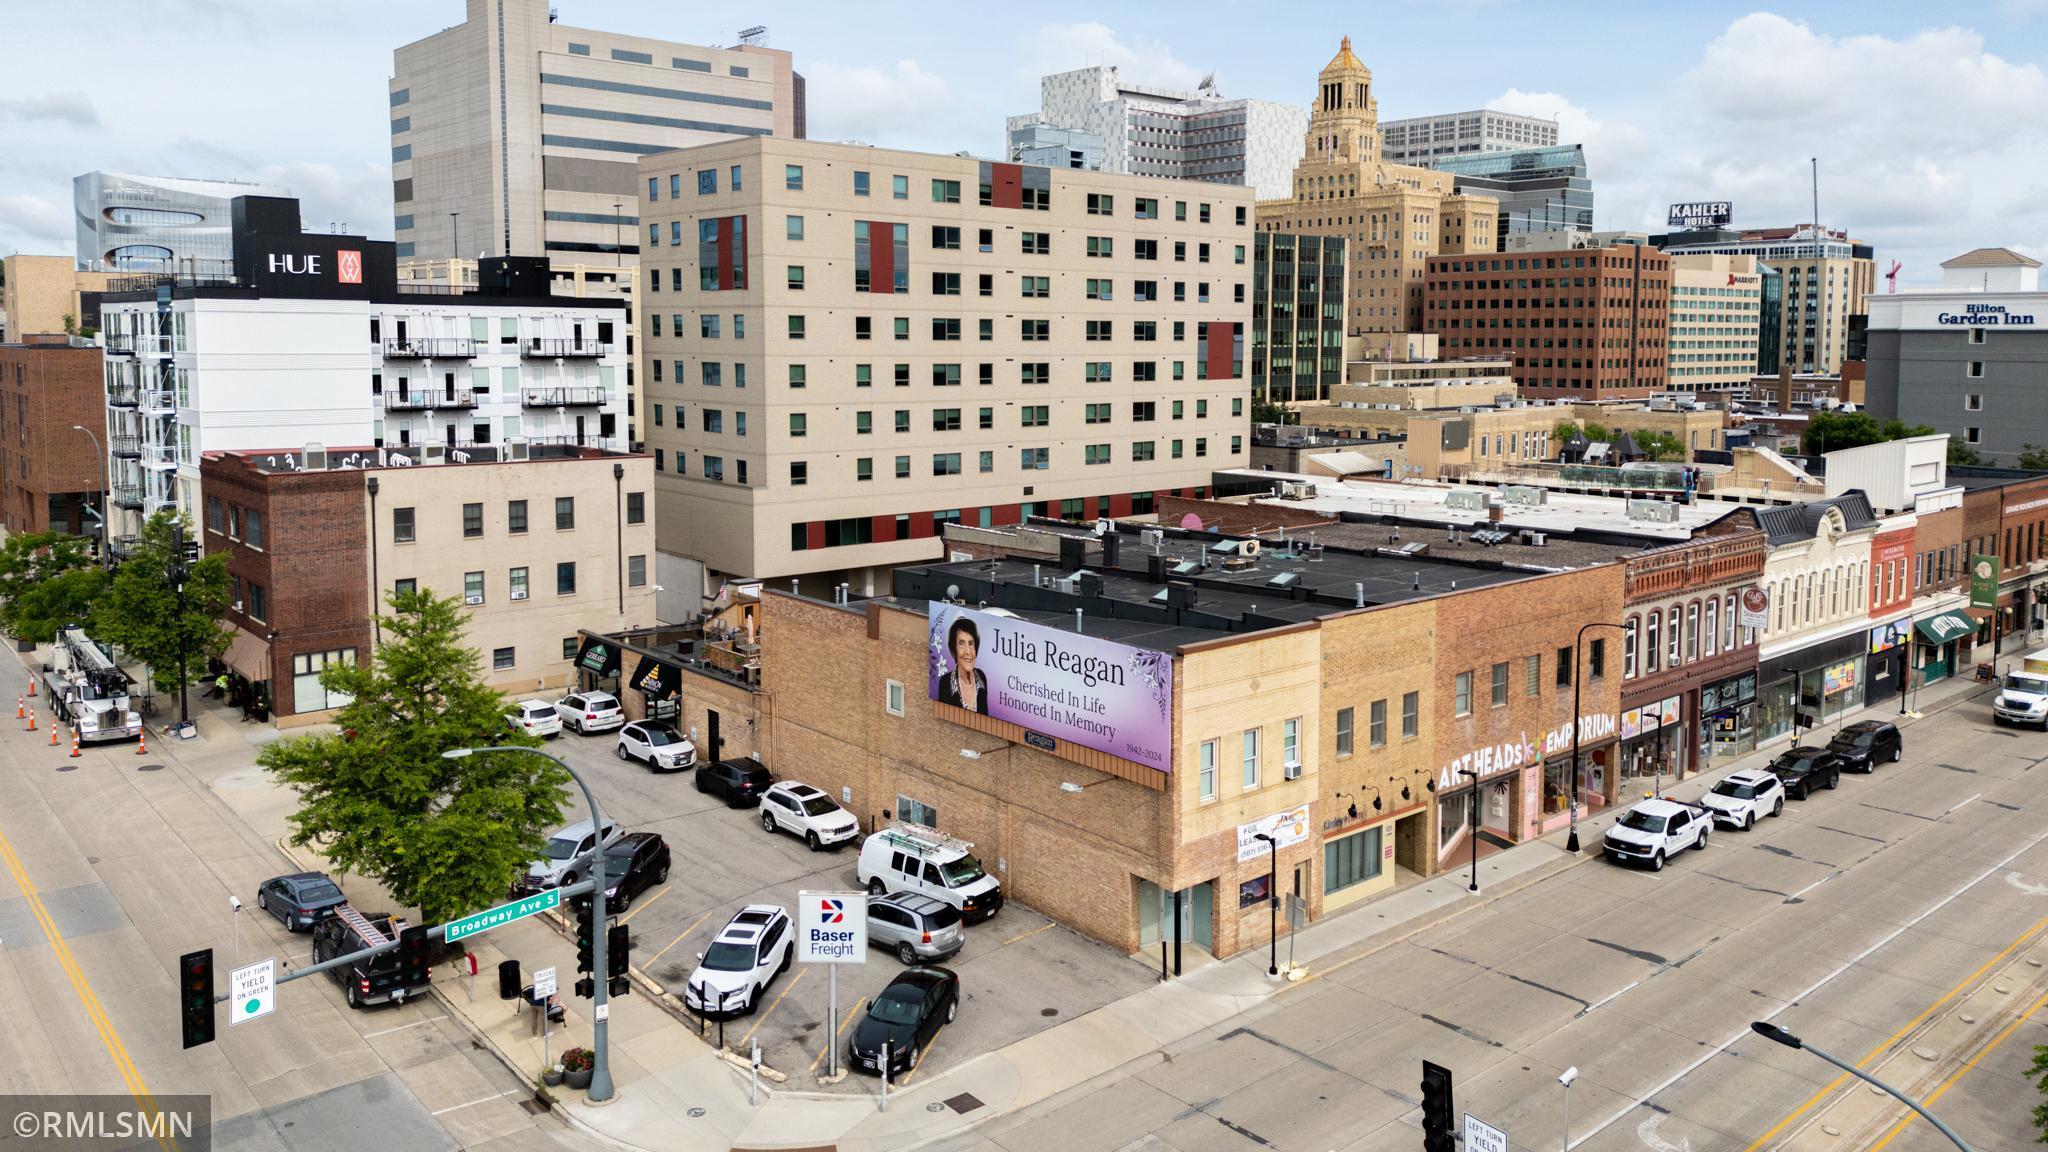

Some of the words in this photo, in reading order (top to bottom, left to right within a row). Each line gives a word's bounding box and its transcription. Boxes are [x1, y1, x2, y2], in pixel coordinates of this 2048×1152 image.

[1671, 203, 1728, 217] KAHLER
[1684, 216, 1714, 226] HOTEL
[268, 253, 321, 275] HUE
[1734, 275, 1759, 285] MARRIOTT
[1966, 304, 2006, 313] Hilton
[1938, 312, 1998, 325] Garden
[2003, 312, 2034, 325] Inn
[992, 627, 1037, 663] Julia
[1044, 640, 1125, 687] Reagan
[1007, 675, 1065, 704] Cherished
[1068, 691, 1080, 708] In
[1083, 695, 1106, 716] Life
[998, 691, 1047, 718] Honored
[1050, 705, 1062, 723] In
[1065, 711, 1116, 742] Memory
[1027, 732, 1054, 748] Reagan
[1126, 743, 1162, 762] 1942-2024
[1437, 753, 1472, 790] ART
[1474, 743, 1523, 778] HEADS
[1546, 713, 1616, 754] EMPORIUM
[1243, 825, 1258, 835] FOR
[1239, 835, 1260, 847] LEAS
[451, 910, 513, 937] Broadway
[519, 901, 542, 914] Ave
[547, 894, 554, 904] S
[810, 928, 855, 942] Baser
[811, 942, 854, 958] Freight
[235, 970, 251, 981] LEFT
[254, 965, 270, 976] TURN
[241, 975, 265, 990] YIELD
[237, 992, 246, 1001] ON
[248, 985, 269, 997] GREEN
[1468, 1121, 1483, 1134] LEFT
[1486, 1130, 1503, 1145] TURN
[1473, 1135, 1498, 1152] YIELD
